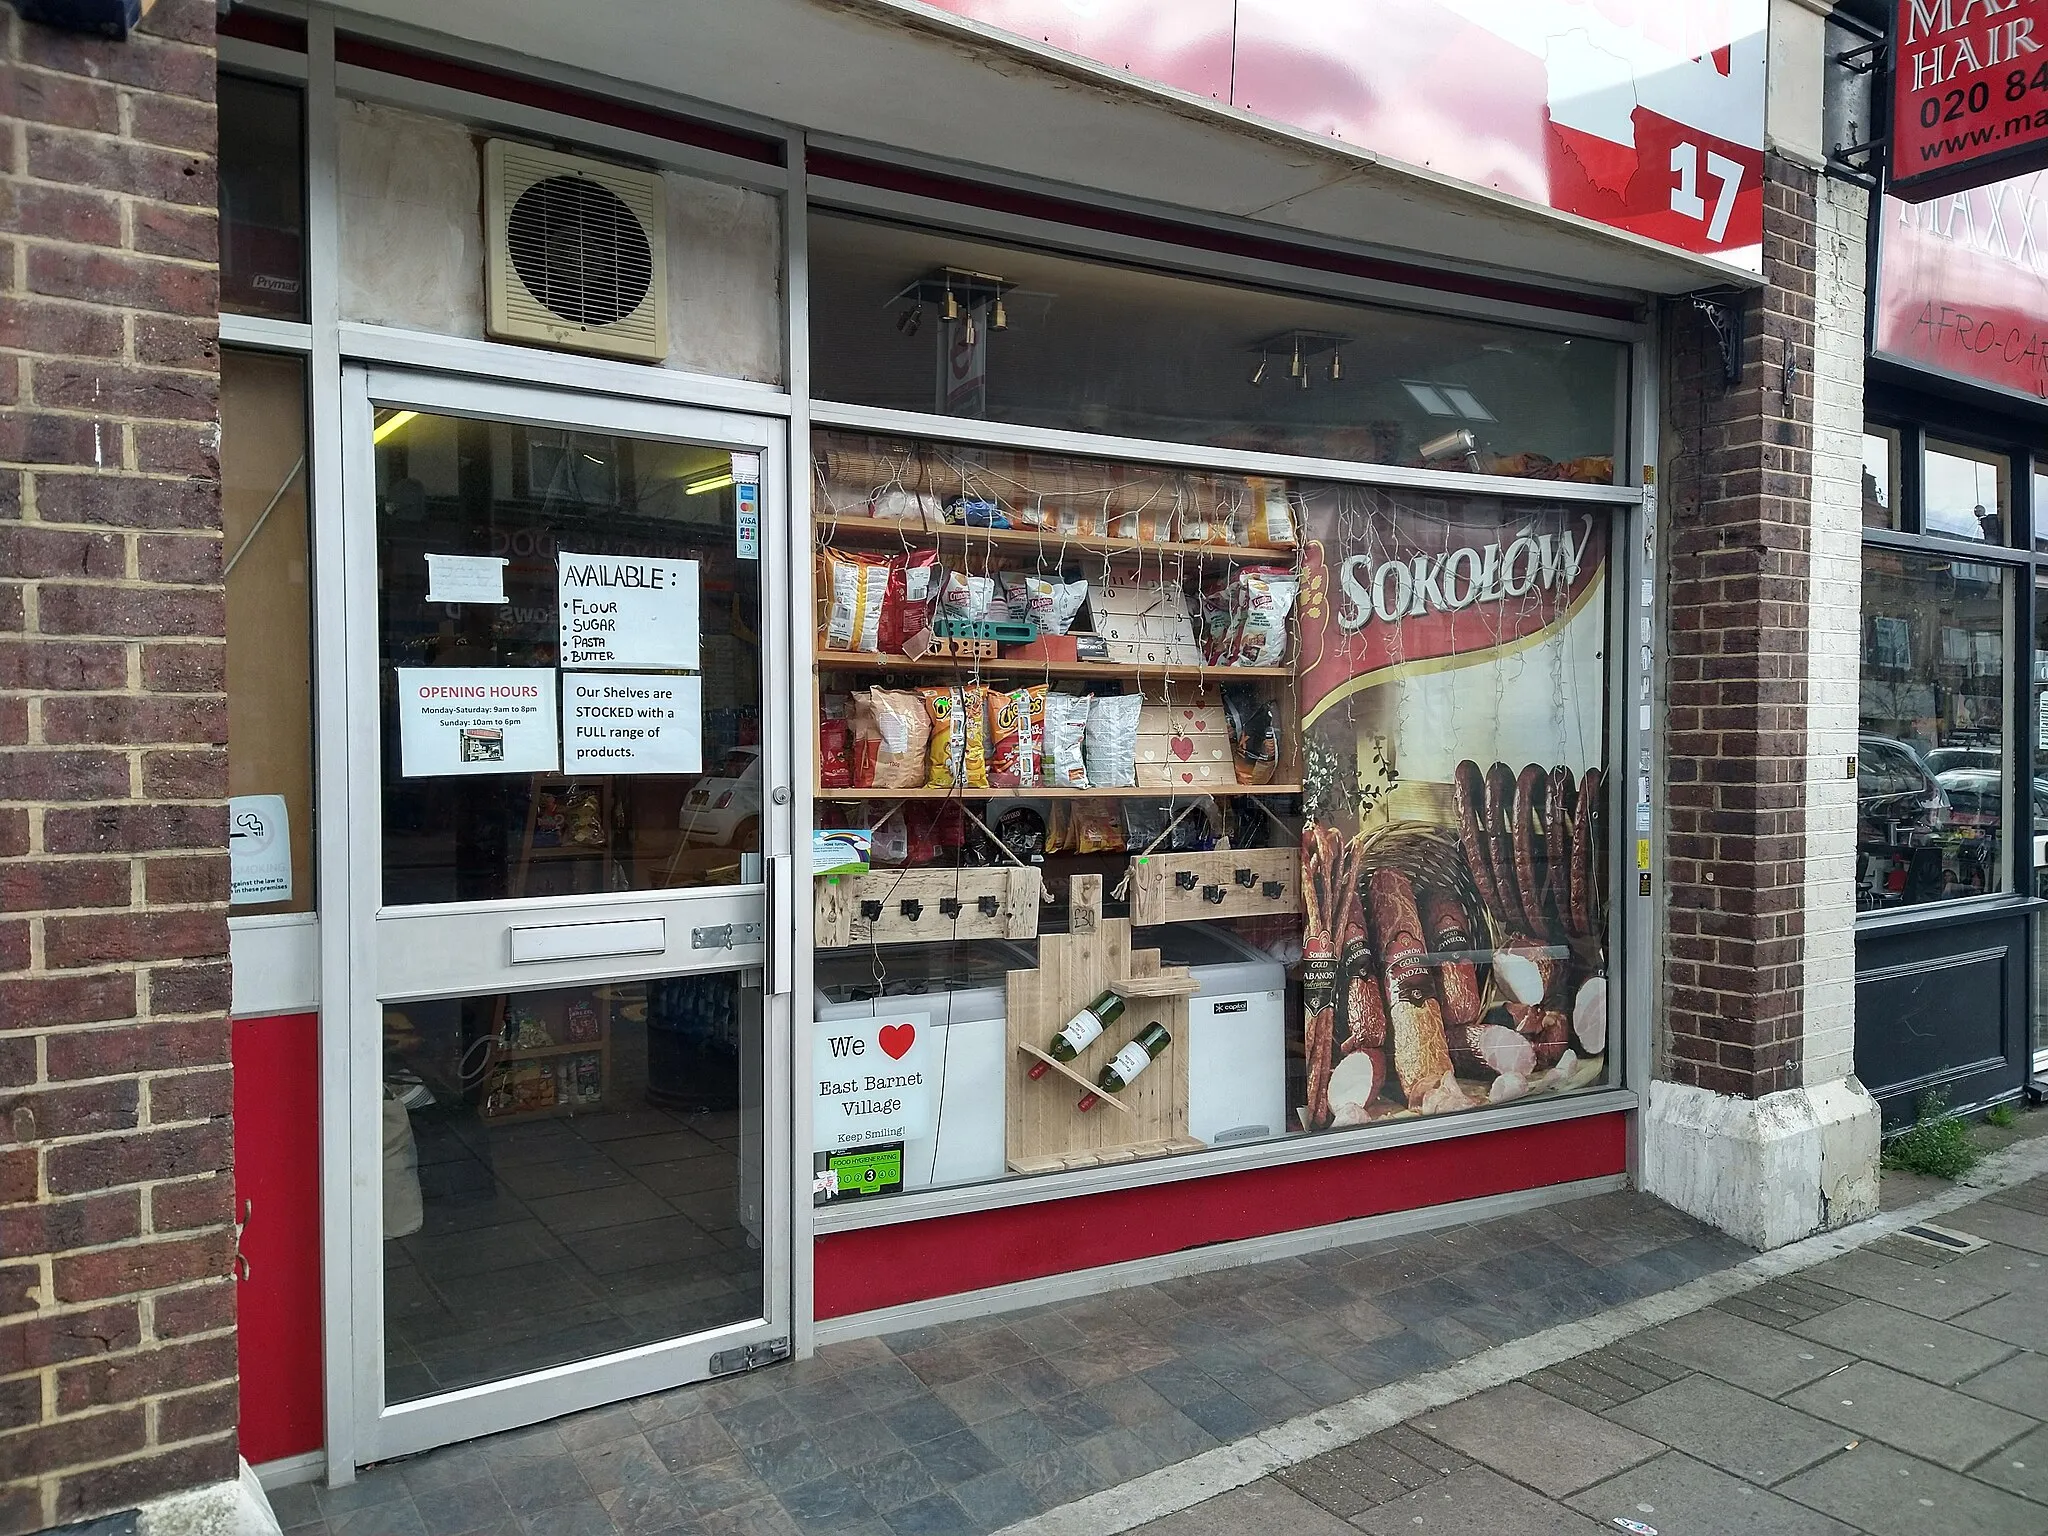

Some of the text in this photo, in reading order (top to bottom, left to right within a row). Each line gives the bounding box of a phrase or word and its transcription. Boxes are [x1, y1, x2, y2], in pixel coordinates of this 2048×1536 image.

[1905, 0, 2036, 45] MA
[1911, 17, 2044, 92] HAIR
[1920, 82, 1989, 128] 020
[1671, 141, 1744, 243] 17
[257, 277, 297, 291] Prymat
[564, 563, 664, 589] AVAILABLE
[1338, 513, 1593, 629] SOKOŁÓW
[572, 598, 617, 615] FLOUR
[1101, 609, 1108, 617] 9
[573, 618, 616, 632] SUGAR
[1111, 630, 1118, 639] 8
[574, 636, 605, 648] PASTA
[1128, 645, 1134, 653] 7
[571, 650, 615, 662] BUTTER
[1148, 653, 1154, 661] 6
[419, 685, 538, 699] OPENING HOURS
[576, 686, 672, 700] Our Shelves are
[422, 706, 492, 716] Monday-Saturday:
[521, 705, 537, 715] 8pm
[576, 706, 675, 719] STOCKED with a
[440, 718, 470, 728] Sunday:
[472, 718, 492, 726] 10am
[505, 718, 521, 728] 6pm
[577, 726, 660, 741] FULL range of
[577, 746, 635, 759] products.
[260, 884, 288, 892] premises
[1399, 957, 1420, 968] GOLD
[828, 1036, 865, 1058] We
[819, 1072, 923, 1096] East Barnet
[842, 1098, 901, 1116] Village
[838, 1126, 905, 1143] Keep Smiling!
[867, 1171, 873, 1180] 3
